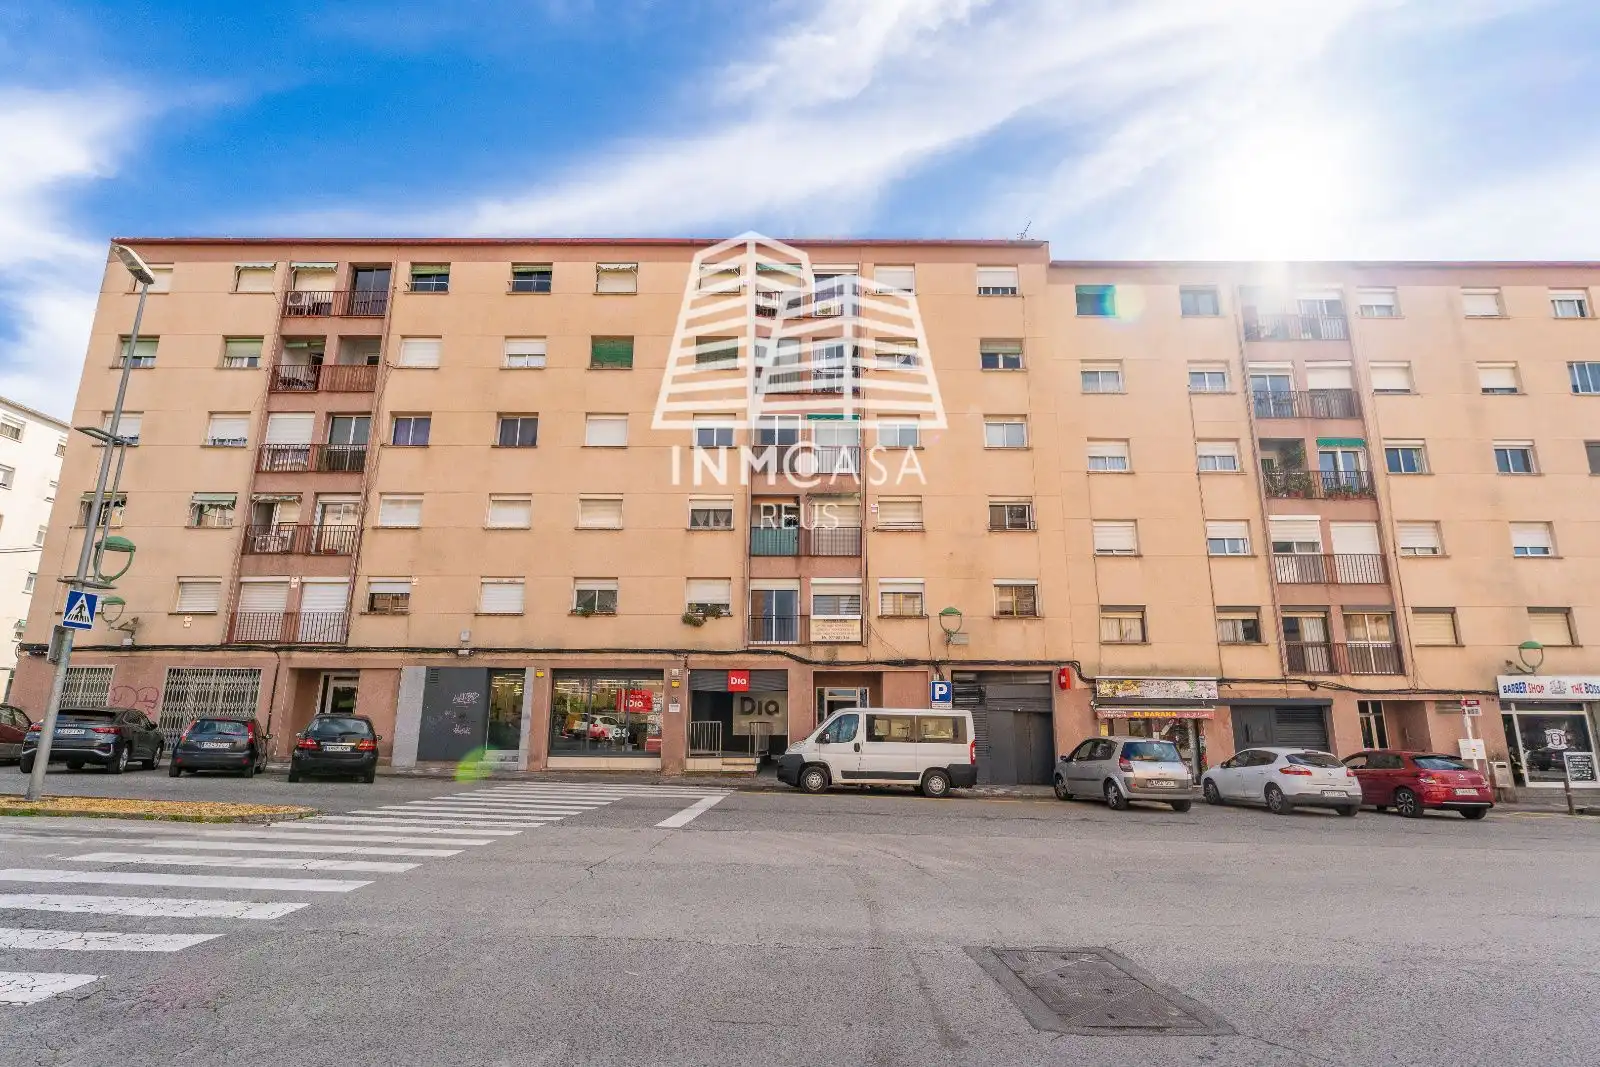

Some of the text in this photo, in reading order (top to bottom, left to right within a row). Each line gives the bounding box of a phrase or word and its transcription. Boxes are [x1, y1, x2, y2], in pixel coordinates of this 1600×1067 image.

[730, 676, 747, 685] Dia
[935, 683, 948, 700] P
[1502, 681, 1528, 694] BARBER
[1528, 682, 1545, 694] SHOP
[1571, 682, 1584, 694] THE
